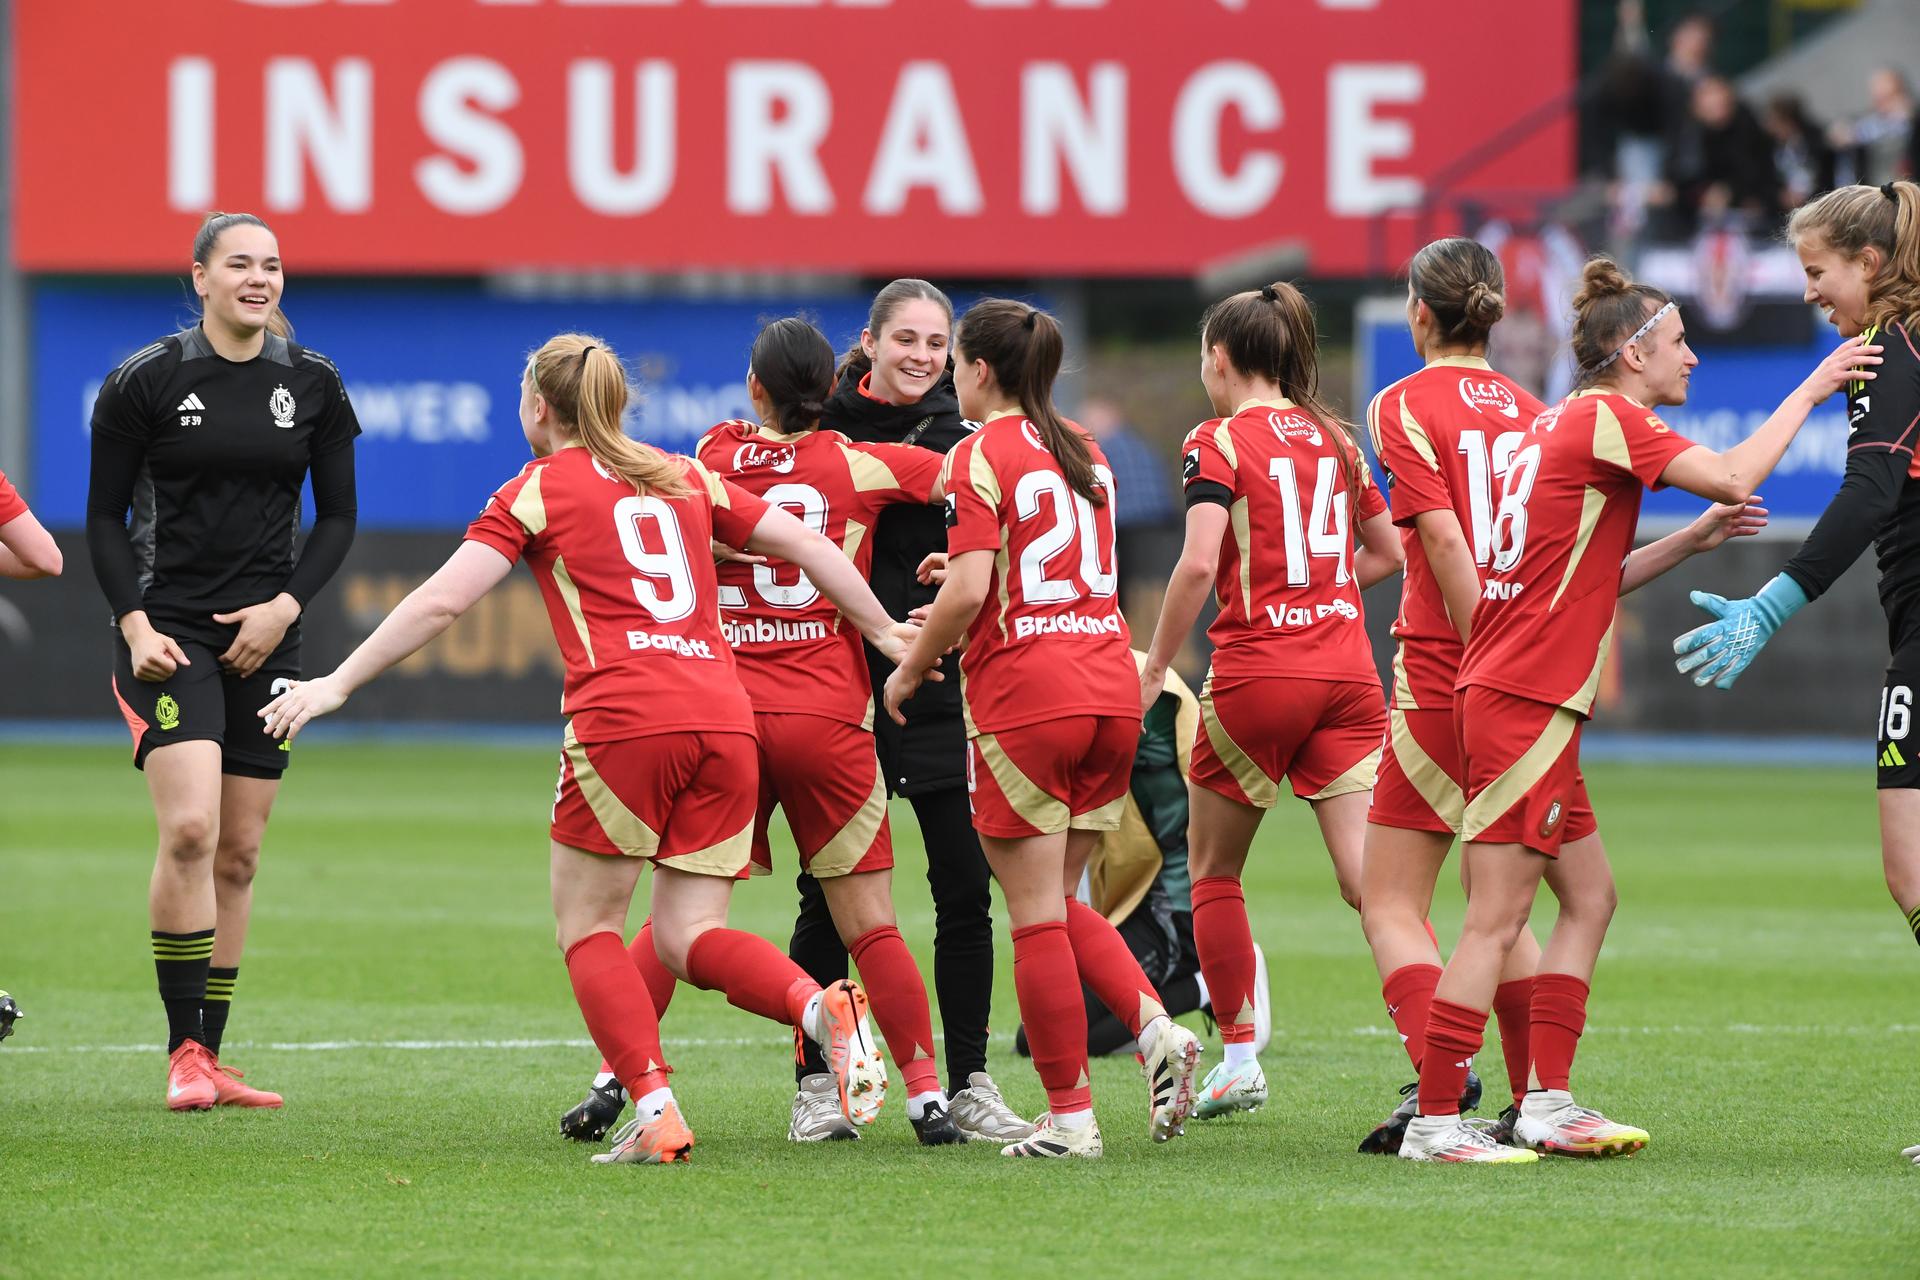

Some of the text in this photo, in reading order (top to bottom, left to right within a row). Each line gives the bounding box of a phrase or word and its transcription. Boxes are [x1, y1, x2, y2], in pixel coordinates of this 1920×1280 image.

[166, 54, 1426, 217] INSURANCE
[180, 415, 202, 427] SF 39
[613, 495, 697, 624] 9
[1014, 464, 1118, 605] 20
[1268, 456, 1353, 588] 14
[1264, 603, 1314, 628] Van
[1481, 578, 1526, 600] ave
[1878, 685, 1913, 742] 16
